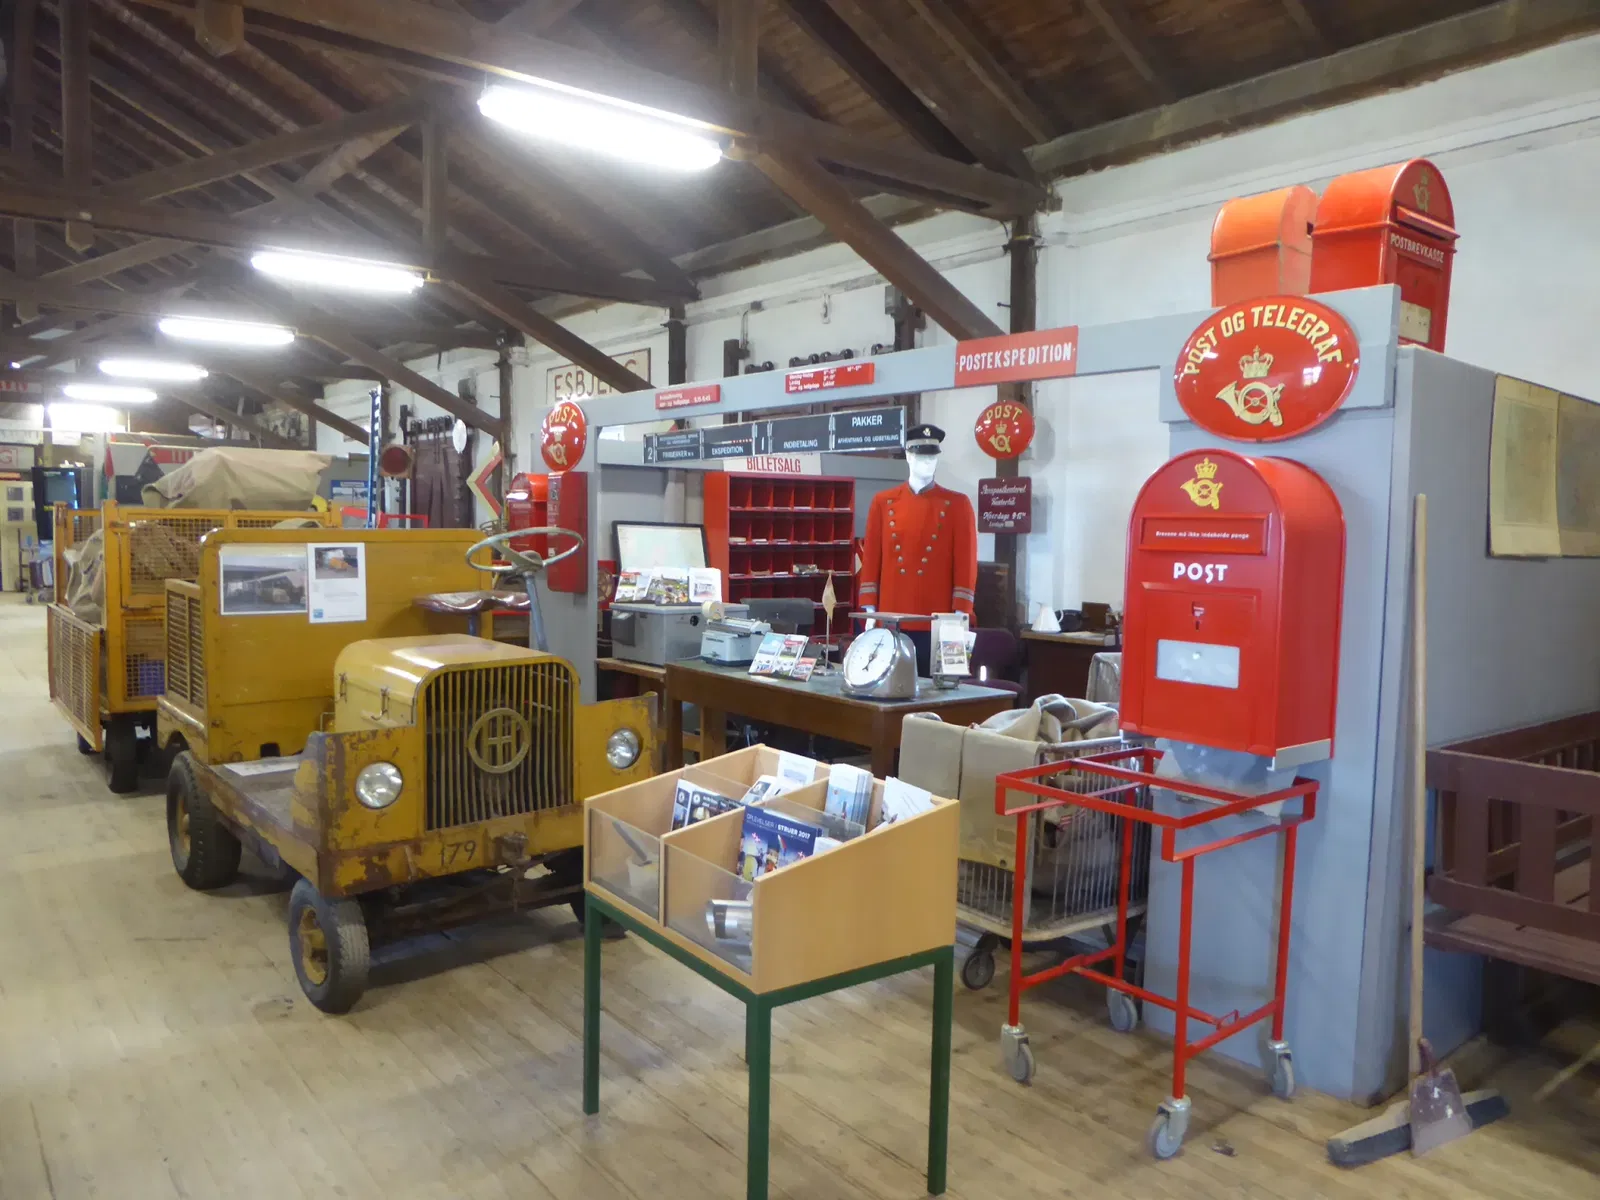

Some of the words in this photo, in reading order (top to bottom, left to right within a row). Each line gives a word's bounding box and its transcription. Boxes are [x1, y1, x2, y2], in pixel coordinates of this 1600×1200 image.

[1390, 233, 1445, 263] POSTBREVKASSE
[1184, 326, 1217, 375] POST
[1220, 310, 1245, 338] OG
[1251, 304, 1343, 363] TELEGRAF
[959, 341, 1073, 372] POSTEKSPEDITION
[548, 405, 578, 428] POST
[852, 414, 883, 427] PAKKER
[986, 404, 1022, 421] POST
[783, 439, 818, 449] INDBETALING
[872, 434, 899, 442] UDBETALING
[647, 447, 653, 460] 2
[711, 446, 744, 456] EKSPEDITION
[746, 455, 801, 473] BILLETSALG
[1173, 562, 1228, 584] POST
[746, 813, 775, 828] OPLEVELSER
[777, 824, 799, 836] STRUER
[798, 830, 811, 840] 2017
